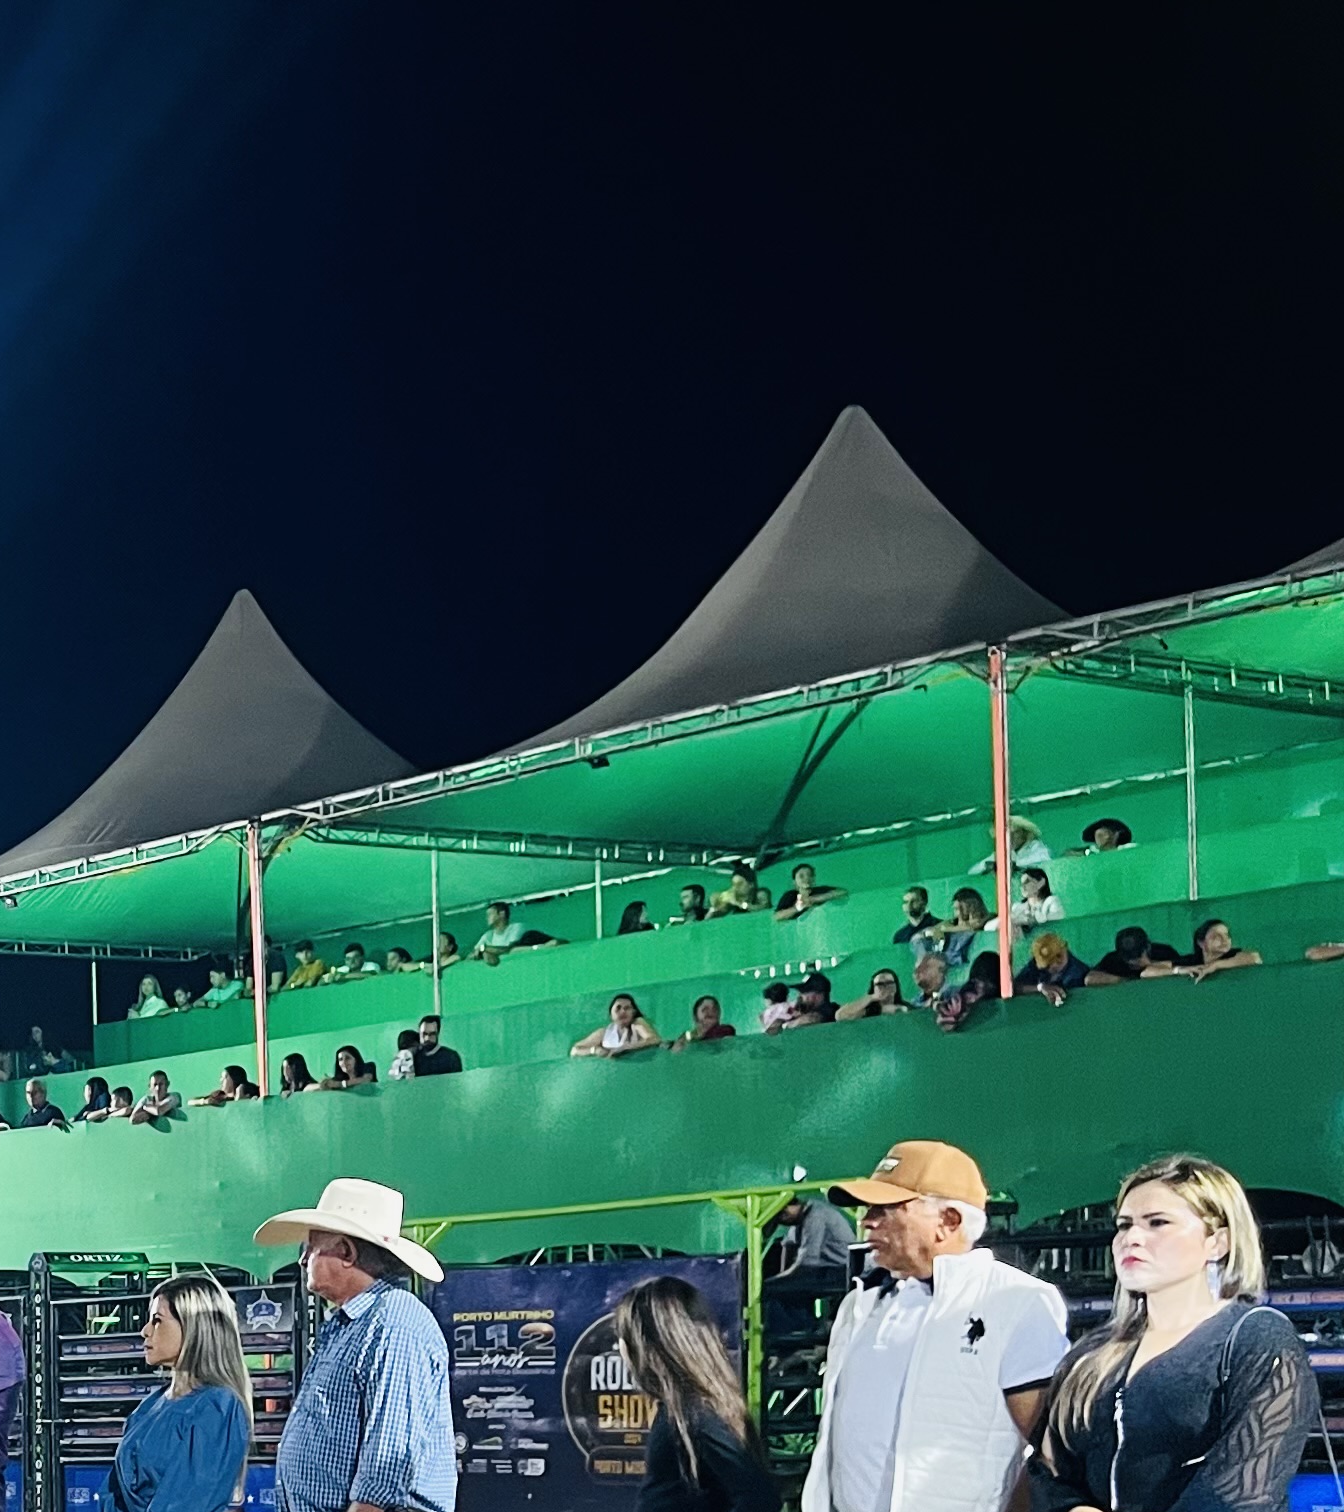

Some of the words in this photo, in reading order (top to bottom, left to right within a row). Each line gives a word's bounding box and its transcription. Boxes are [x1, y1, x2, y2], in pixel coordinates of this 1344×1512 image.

[69, 1254, 124, 1263] ORTIZ
[34, 1293, 43, 1355] ORTIZ
[453, 1322, 556, 1361] 112
